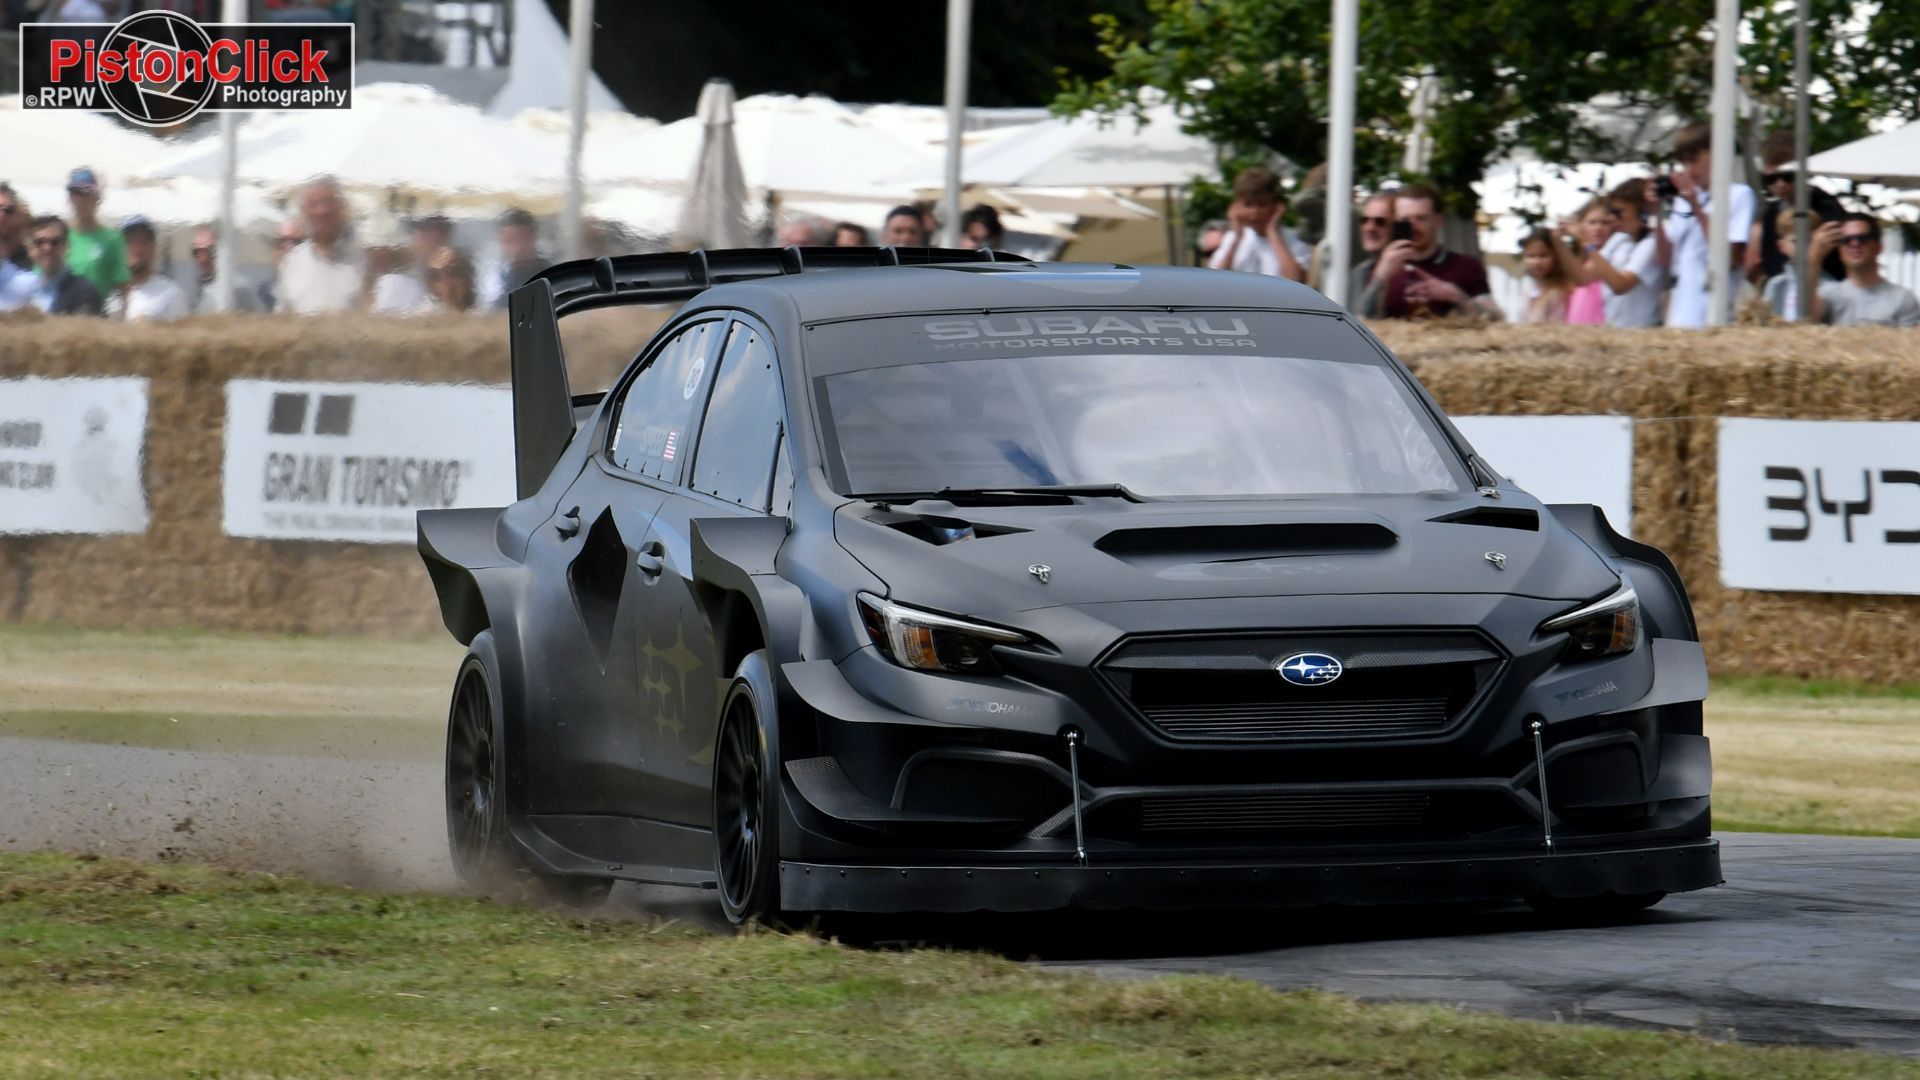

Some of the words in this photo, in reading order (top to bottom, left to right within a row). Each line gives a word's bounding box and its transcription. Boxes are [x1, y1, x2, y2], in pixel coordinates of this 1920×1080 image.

[924, 316, 1250, 341] SUBARU
[933, 337, 1185, 351] MOTORSPORTS
[1192, 338, 1257, 348] USA
